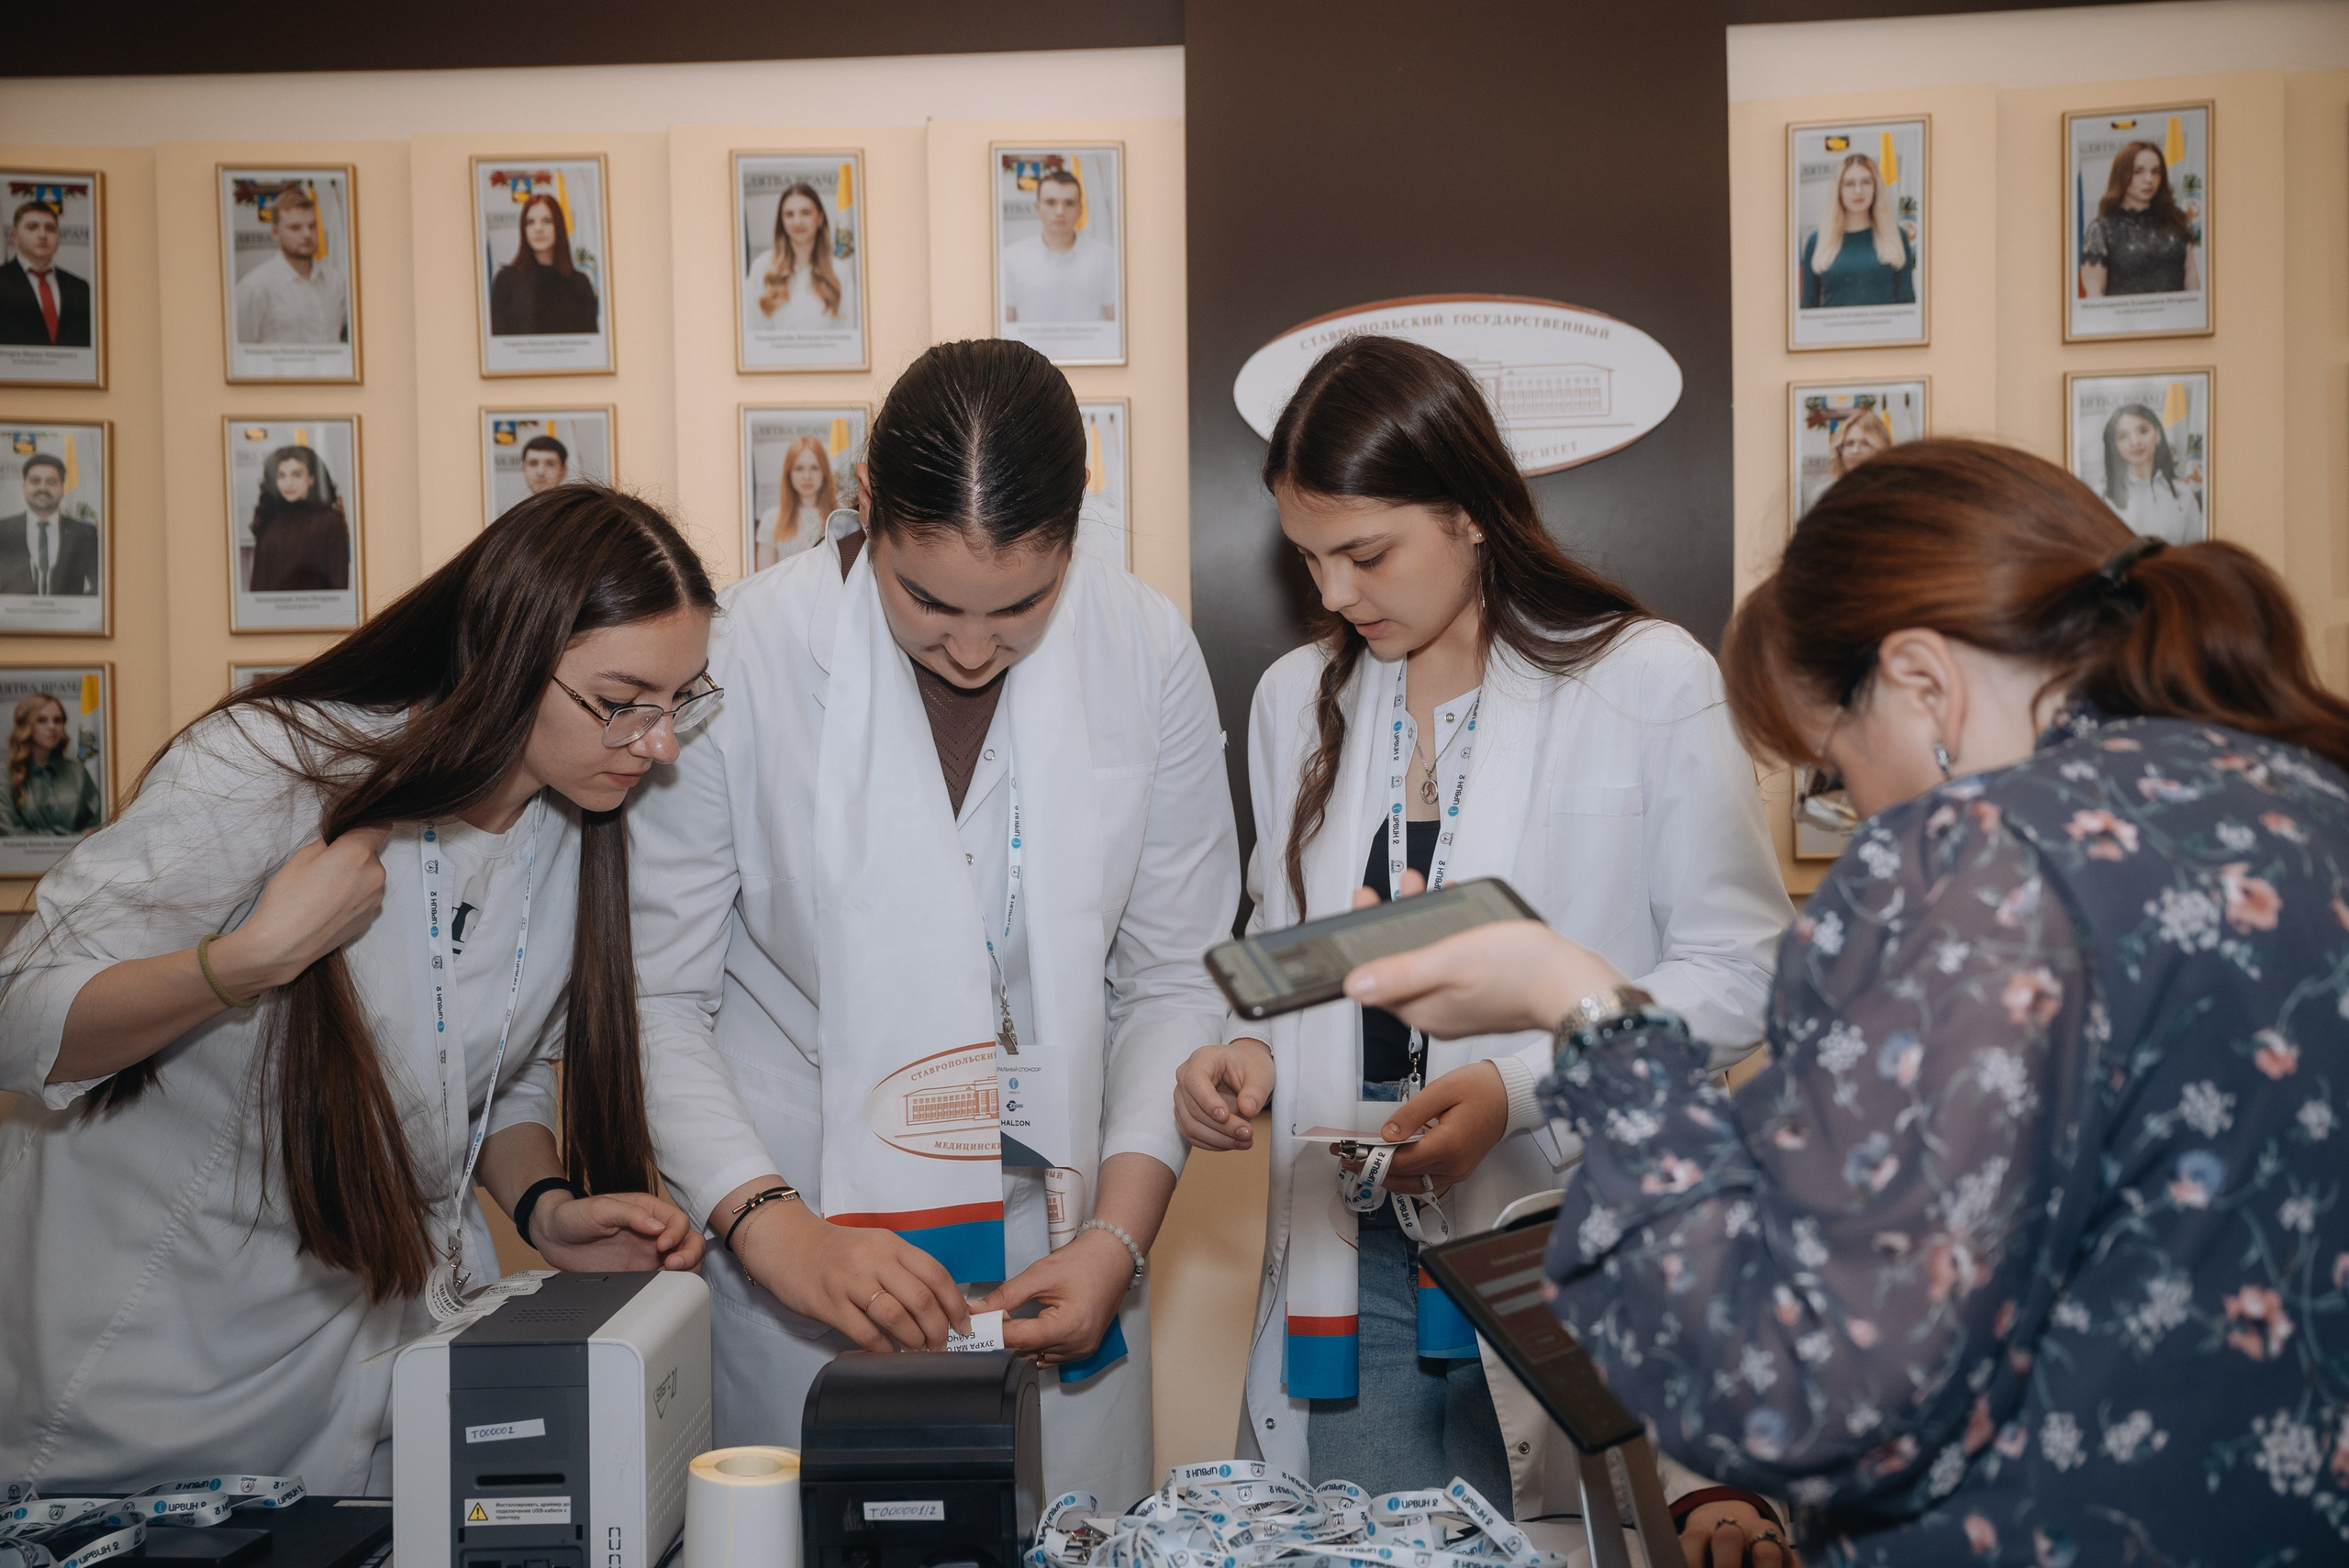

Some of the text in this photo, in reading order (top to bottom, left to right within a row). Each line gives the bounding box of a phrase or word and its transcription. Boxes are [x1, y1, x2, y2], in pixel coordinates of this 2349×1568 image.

[1299, 314, 1610, 350] СТАВРОПОЛЬСКИЙ ГОСУДАРСТВЕННЫЙ
[969, 1340, 995, 1351] ЗУХРА
[1186, 1470, 1191, 1478] 2
[112, 1541, 121, 1551] 2
